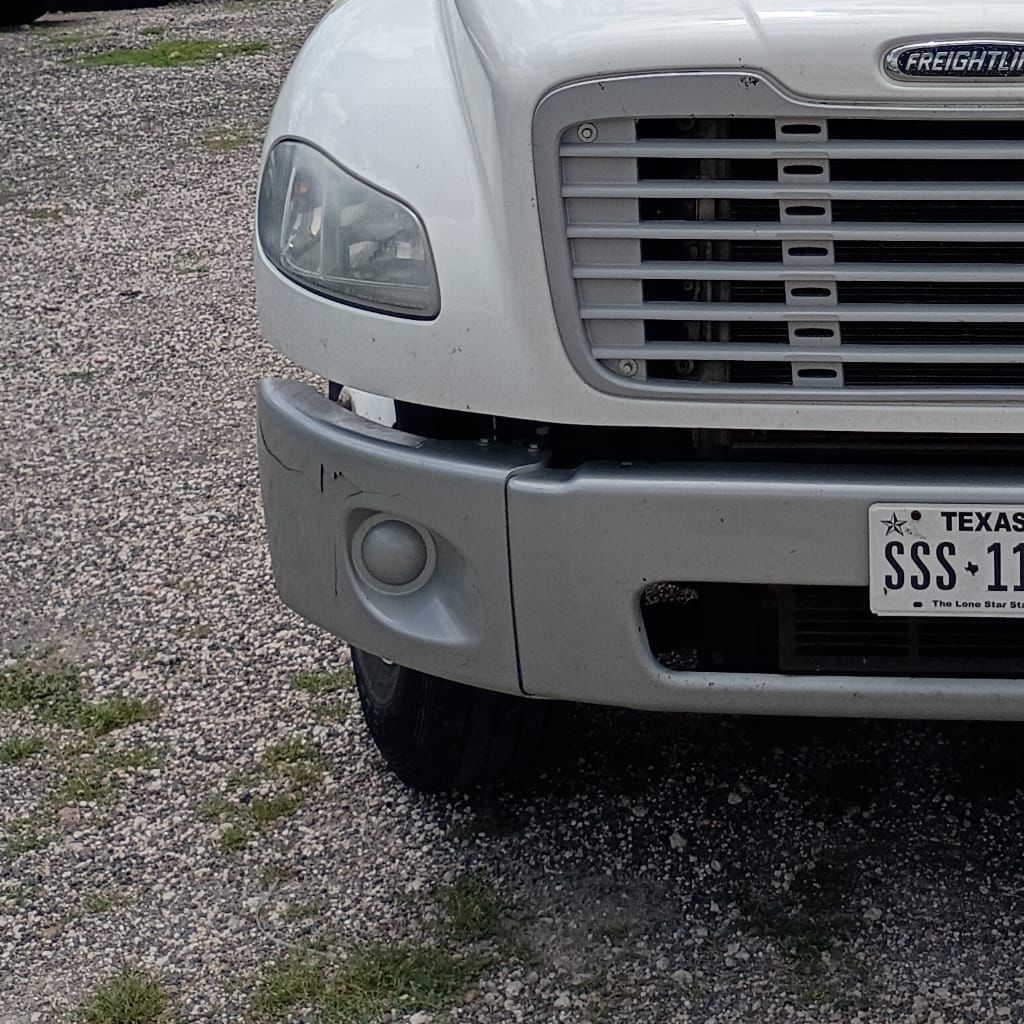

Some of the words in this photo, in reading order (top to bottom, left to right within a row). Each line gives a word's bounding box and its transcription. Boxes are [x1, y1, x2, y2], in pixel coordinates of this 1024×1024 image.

[884, 541, 957, 591] SSS
[932, 600, 953, 608] The
[955, 600, 981, 609] Lone
[984, 601, 1008, 609] Star
